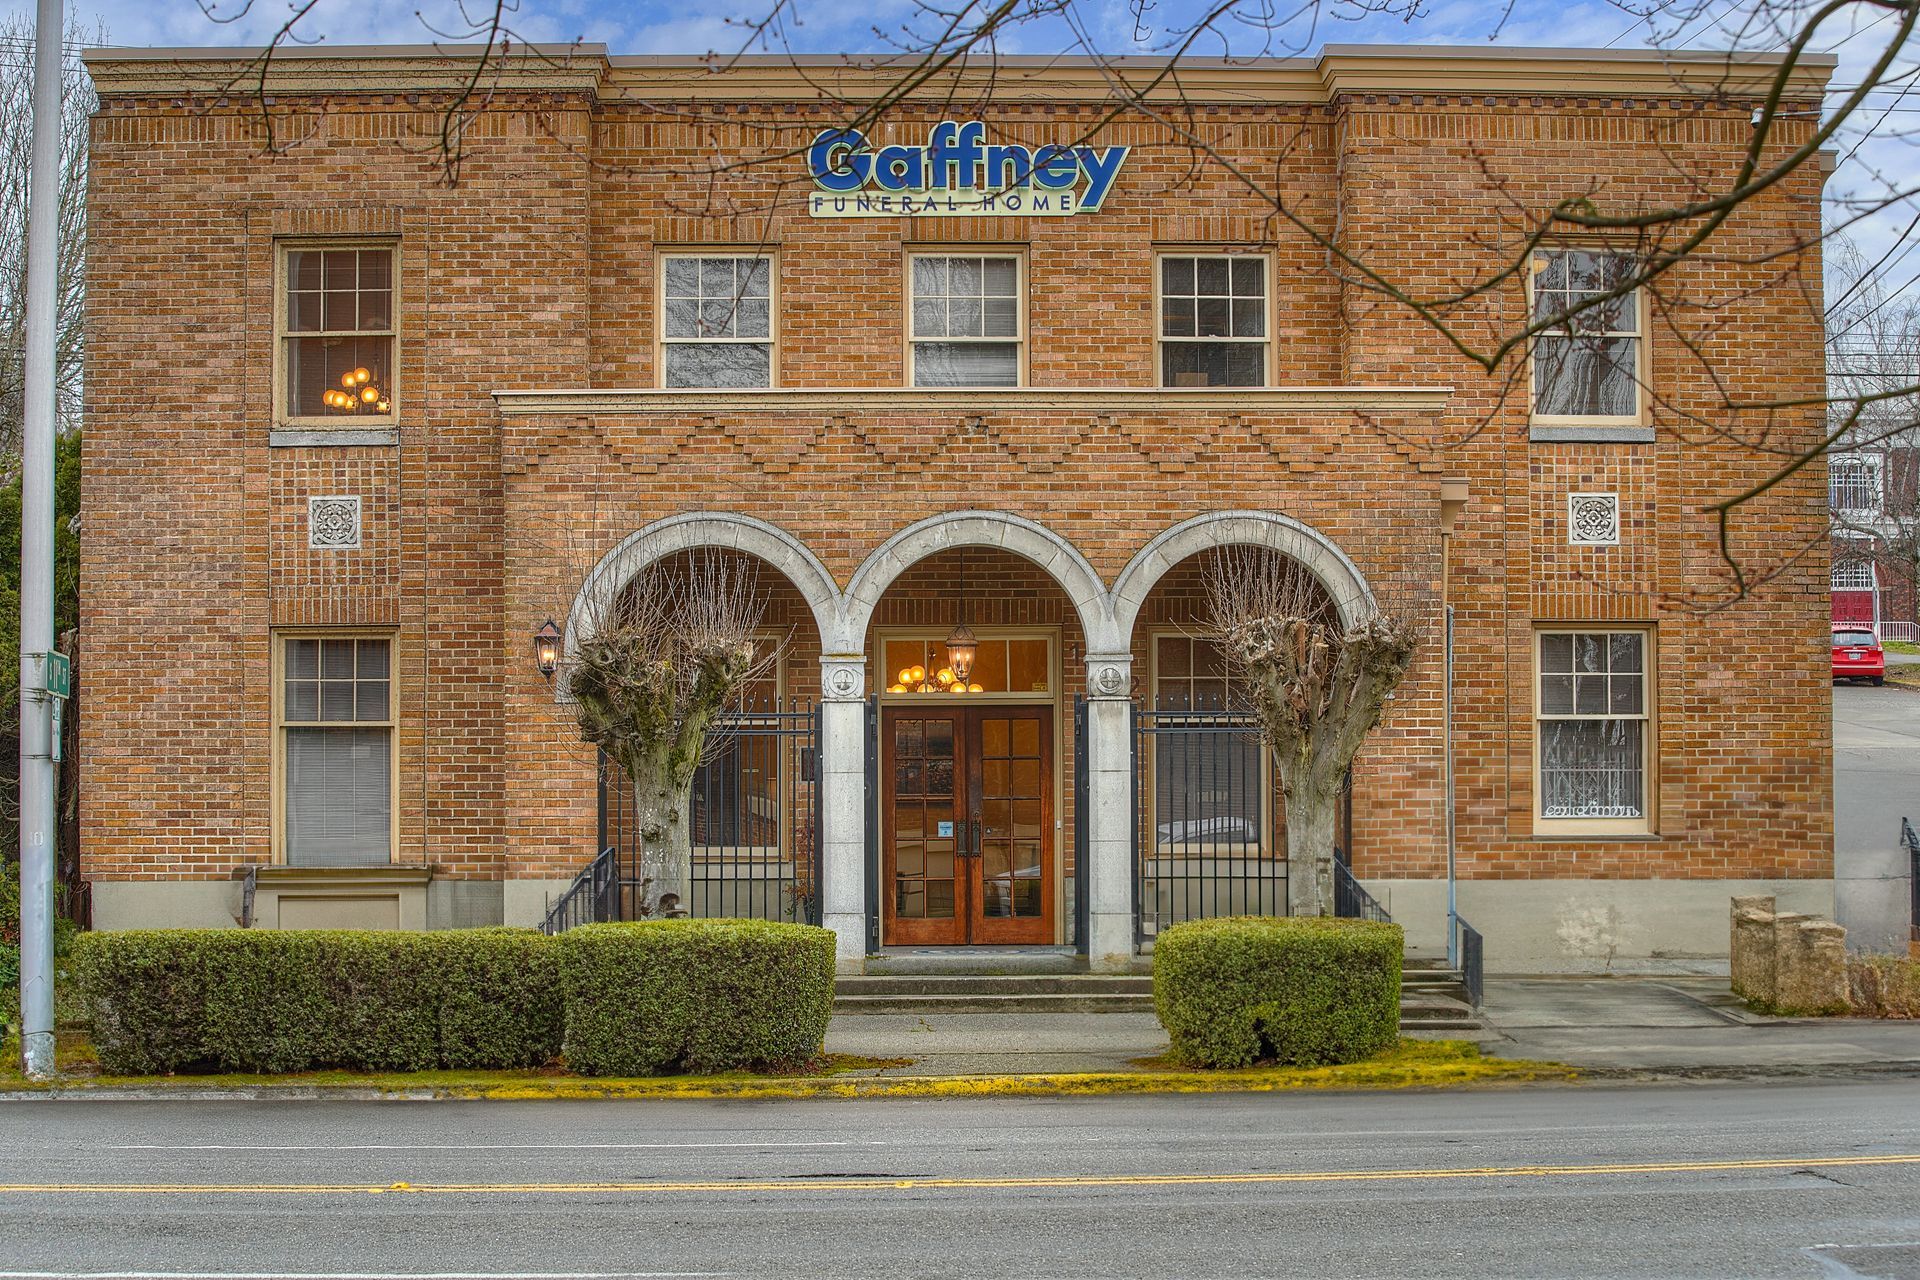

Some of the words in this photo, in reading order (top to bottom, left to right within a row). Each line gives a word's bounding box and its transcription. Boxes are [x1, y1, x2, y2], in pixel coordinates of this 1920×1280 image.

[807, 120, 1132, 213] Gaffney
[813, 194, 957, 214] FUNERAL
[983, 194, 1070, 212] HOME
